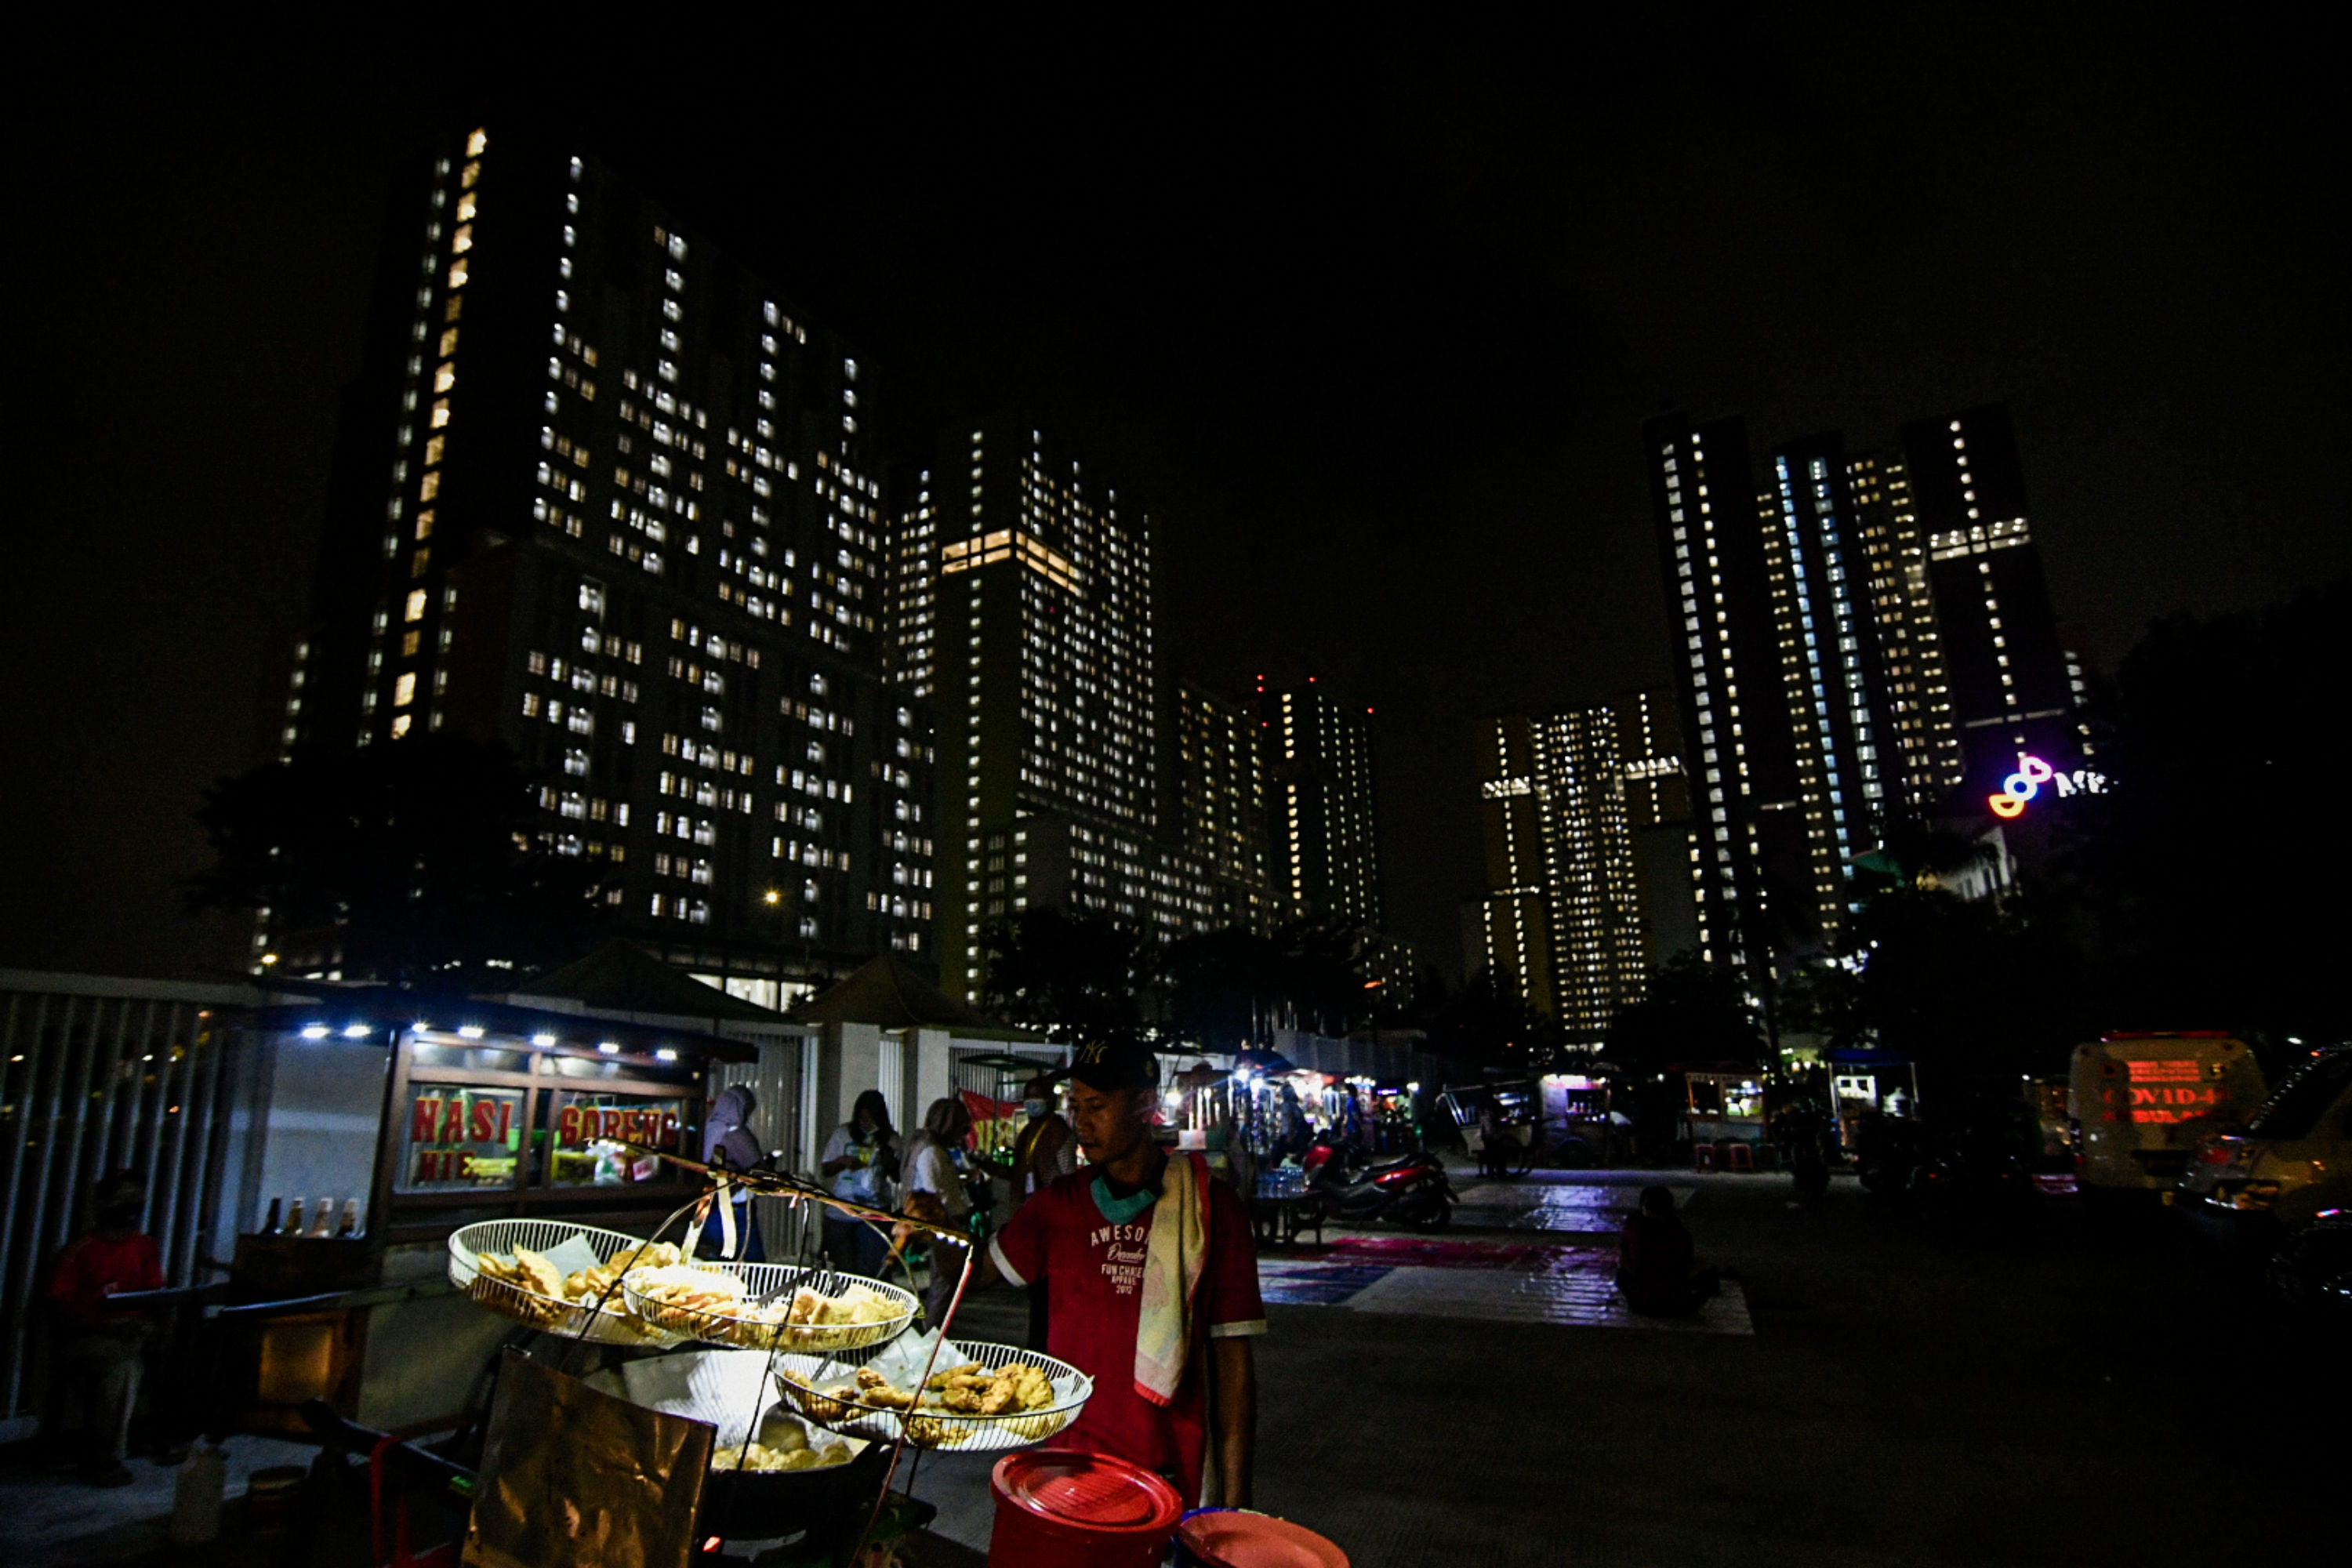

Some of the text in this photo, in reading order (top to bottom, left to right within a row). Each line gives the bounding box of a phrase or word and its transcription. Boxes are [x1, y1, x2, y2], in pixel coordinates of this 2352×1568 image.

[412, 1097, 677, 1147] NASI GORENG
[1101, 1264, 1118, 1276] FUN
